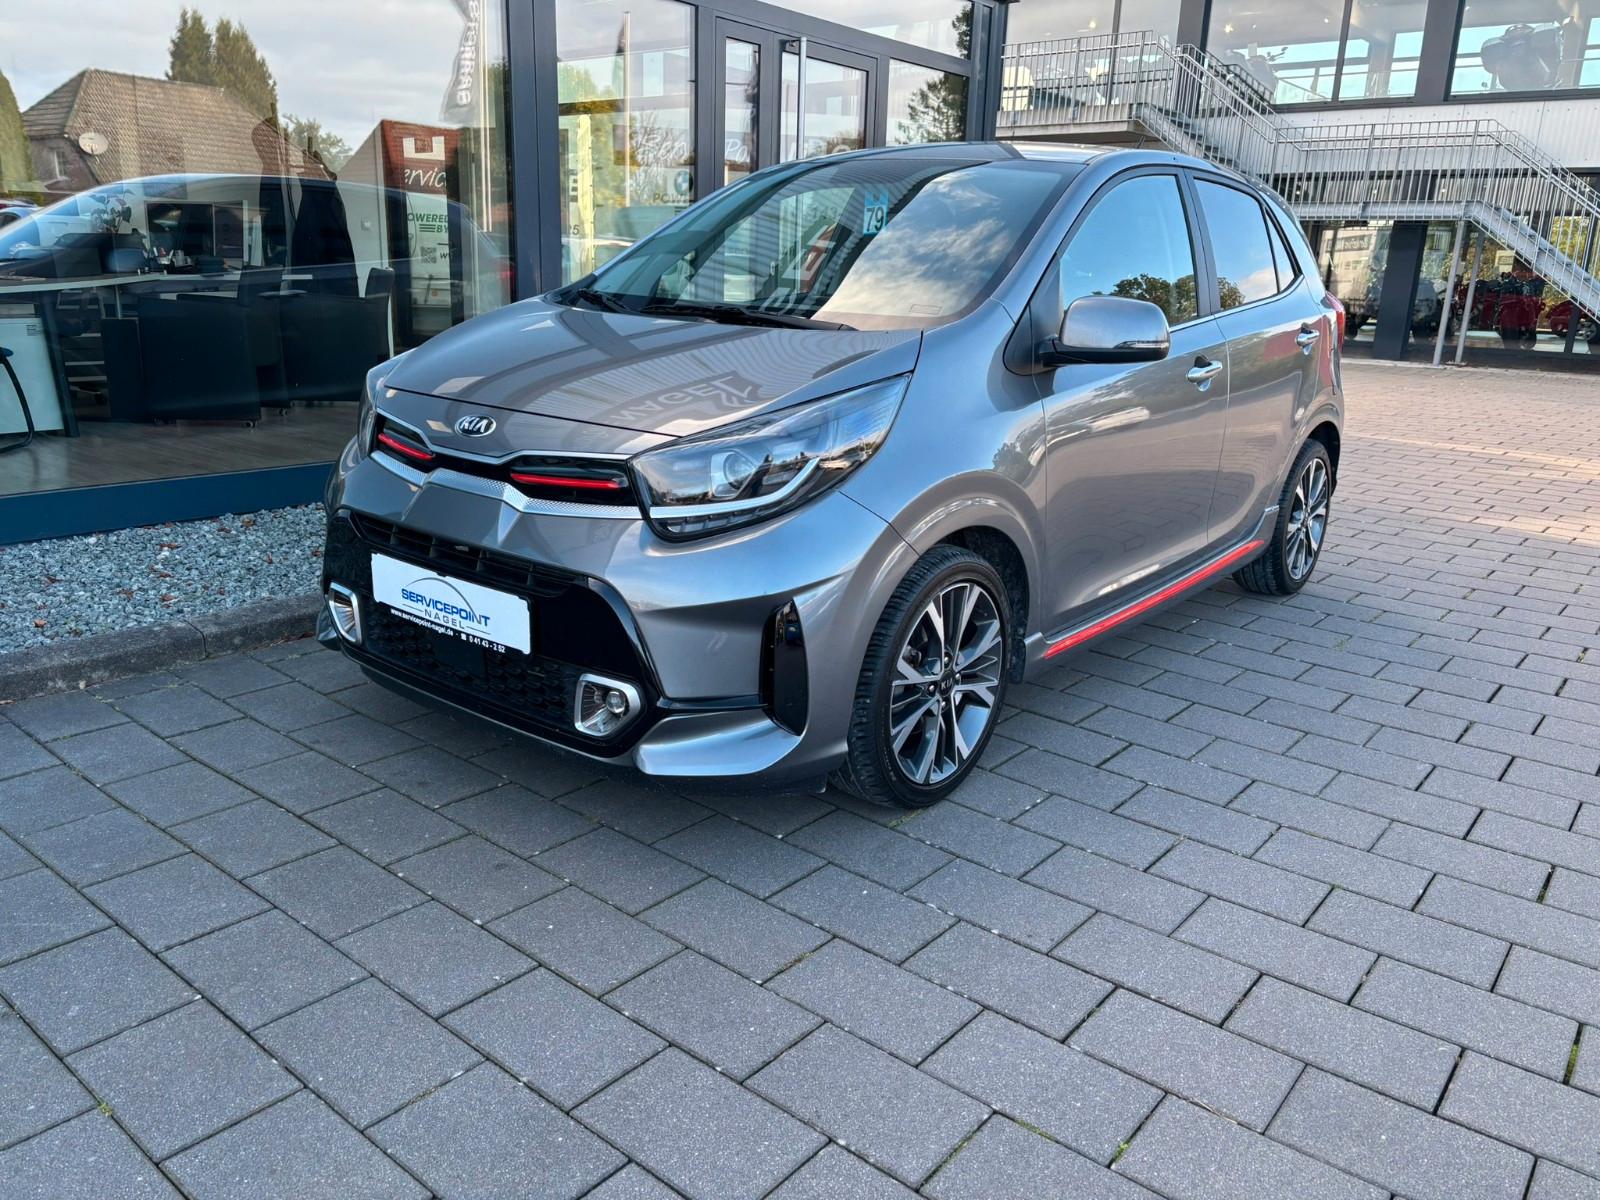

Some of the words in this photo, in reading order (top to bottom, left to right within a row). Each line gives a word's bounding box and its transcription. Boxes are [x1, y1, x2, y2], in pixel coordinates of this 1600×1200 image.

[866, 206, 884, 232] 79
[460, 416, 489, 433] KIA
[401, 588, 491, 627] SERVICEPOINT
[424, 608, 465, 630] NAGEL
[390, 608, 454, 637] www.servicepoint-nagel.de
